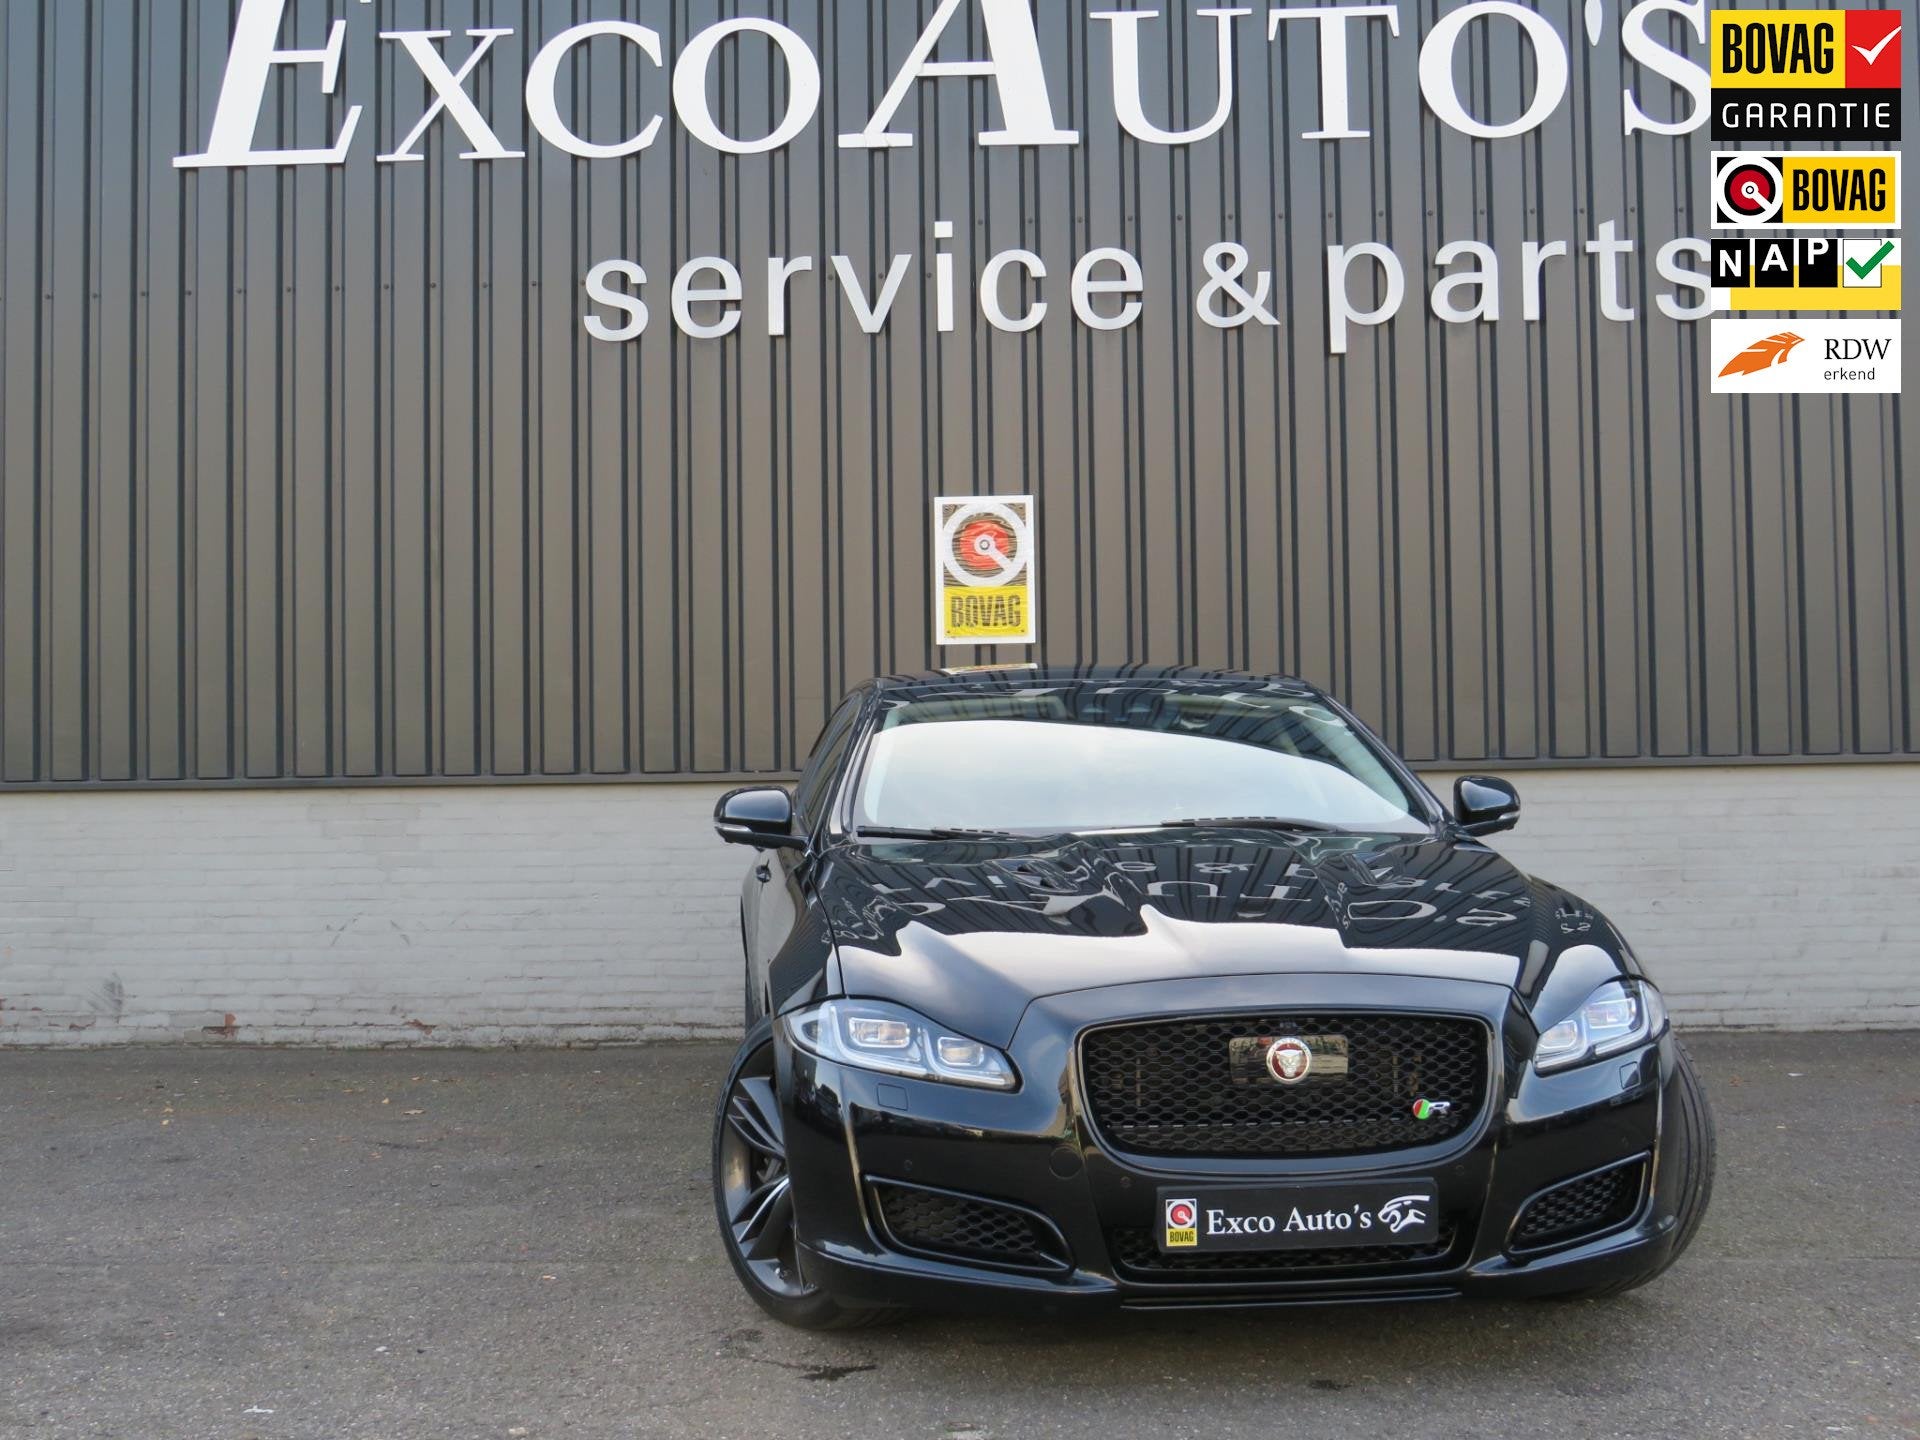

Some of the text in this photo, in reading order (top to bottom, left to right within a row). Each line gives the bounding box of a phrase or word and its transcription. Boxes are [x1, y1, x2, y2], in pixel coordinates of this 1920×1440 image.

[584, 219, 1713, 354] service & parts
[951, 595, 1021, 627] BOVAG
[1206, 1205, 1372, 1235] Exco Auto's
[1169, 1231, 1194, 1242] BOVAG
